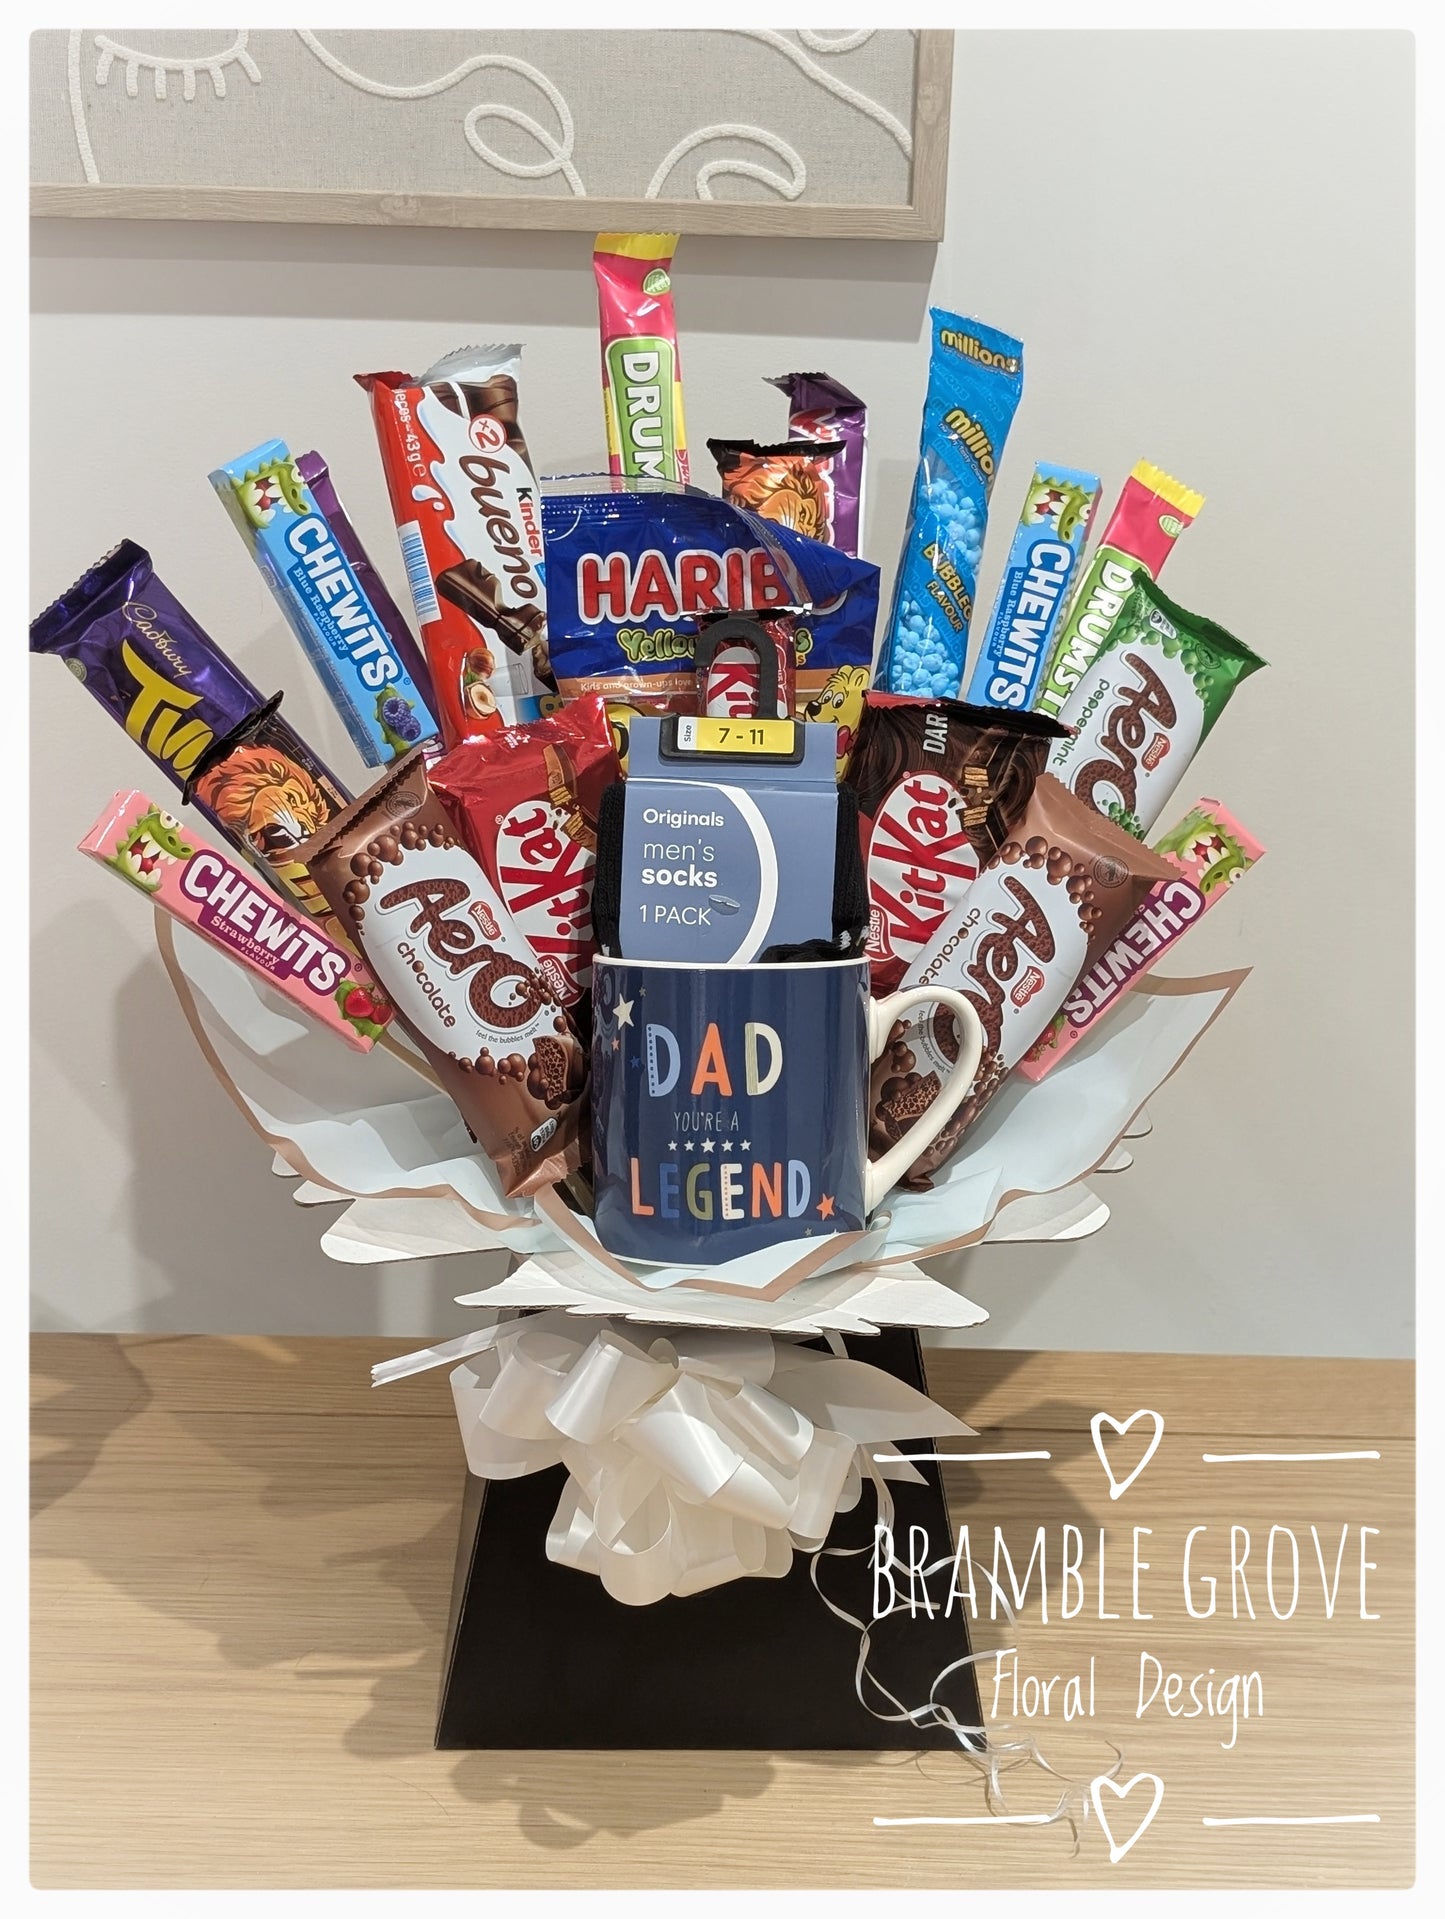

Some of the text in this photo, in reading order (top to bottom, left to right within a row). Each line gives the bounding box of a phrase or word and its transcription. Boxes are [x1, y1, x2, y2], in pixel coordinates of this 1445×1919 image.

[458, 455, 538, 599] bueno
[515, 487, 543, 557] Kinder
[289, 517, 399, 687] CHEWITS
[292, 567, 350, 651] Blue Raspberry
[577, 547, 849, 625] HARIB
[926, 580, 964, 633] FLAVOUR
[993, 570, 1025, 658] Blue Raspberry
[121, 601, 193, 679] Cadbury
[312, 612, 337, 647] FLAVOUR
[989, 542, 1072, 709] CHEWITS
[991, 611, 1004, 648] FLAVOUR
[683, 724, 693, 742] Size
[718, 727, 731, 744] 7
[749, 728, 765, 745] 11
[1073, 651, 1178, 818] Aero
[643, 808, 725, 829] Originals
[643, 838, 715, 863] men's
[641, 864, 718, 888] socks
[869, 779, 978, 946] KitKat
[184, 854, 346, 992] CHEWITS
[210, 915, 281, 966] Strawberry
[639, 904, 712, 926] 1 PACK
[918, 907, 981, 985] chocolate
[240, 946, 277, 971] FLAVOUR
[379, 878, 543, 1029] Aero
[397, 942, 456, 1028] chocolate
[1062, 881, 1202, 1024] CHEWITS
[475, 1029, 488, 1040] feel
[488, 1034, 499, 1043] the
[499, 1035, 524, 1044] bubbles
[645, 1021, 784, 1098] DAD
[919, 1035, 934, 1061] bubbles
[673, 1110, 740, 1132] YOU'RE A
[630, 1156, 812, 1221] LEGEND
